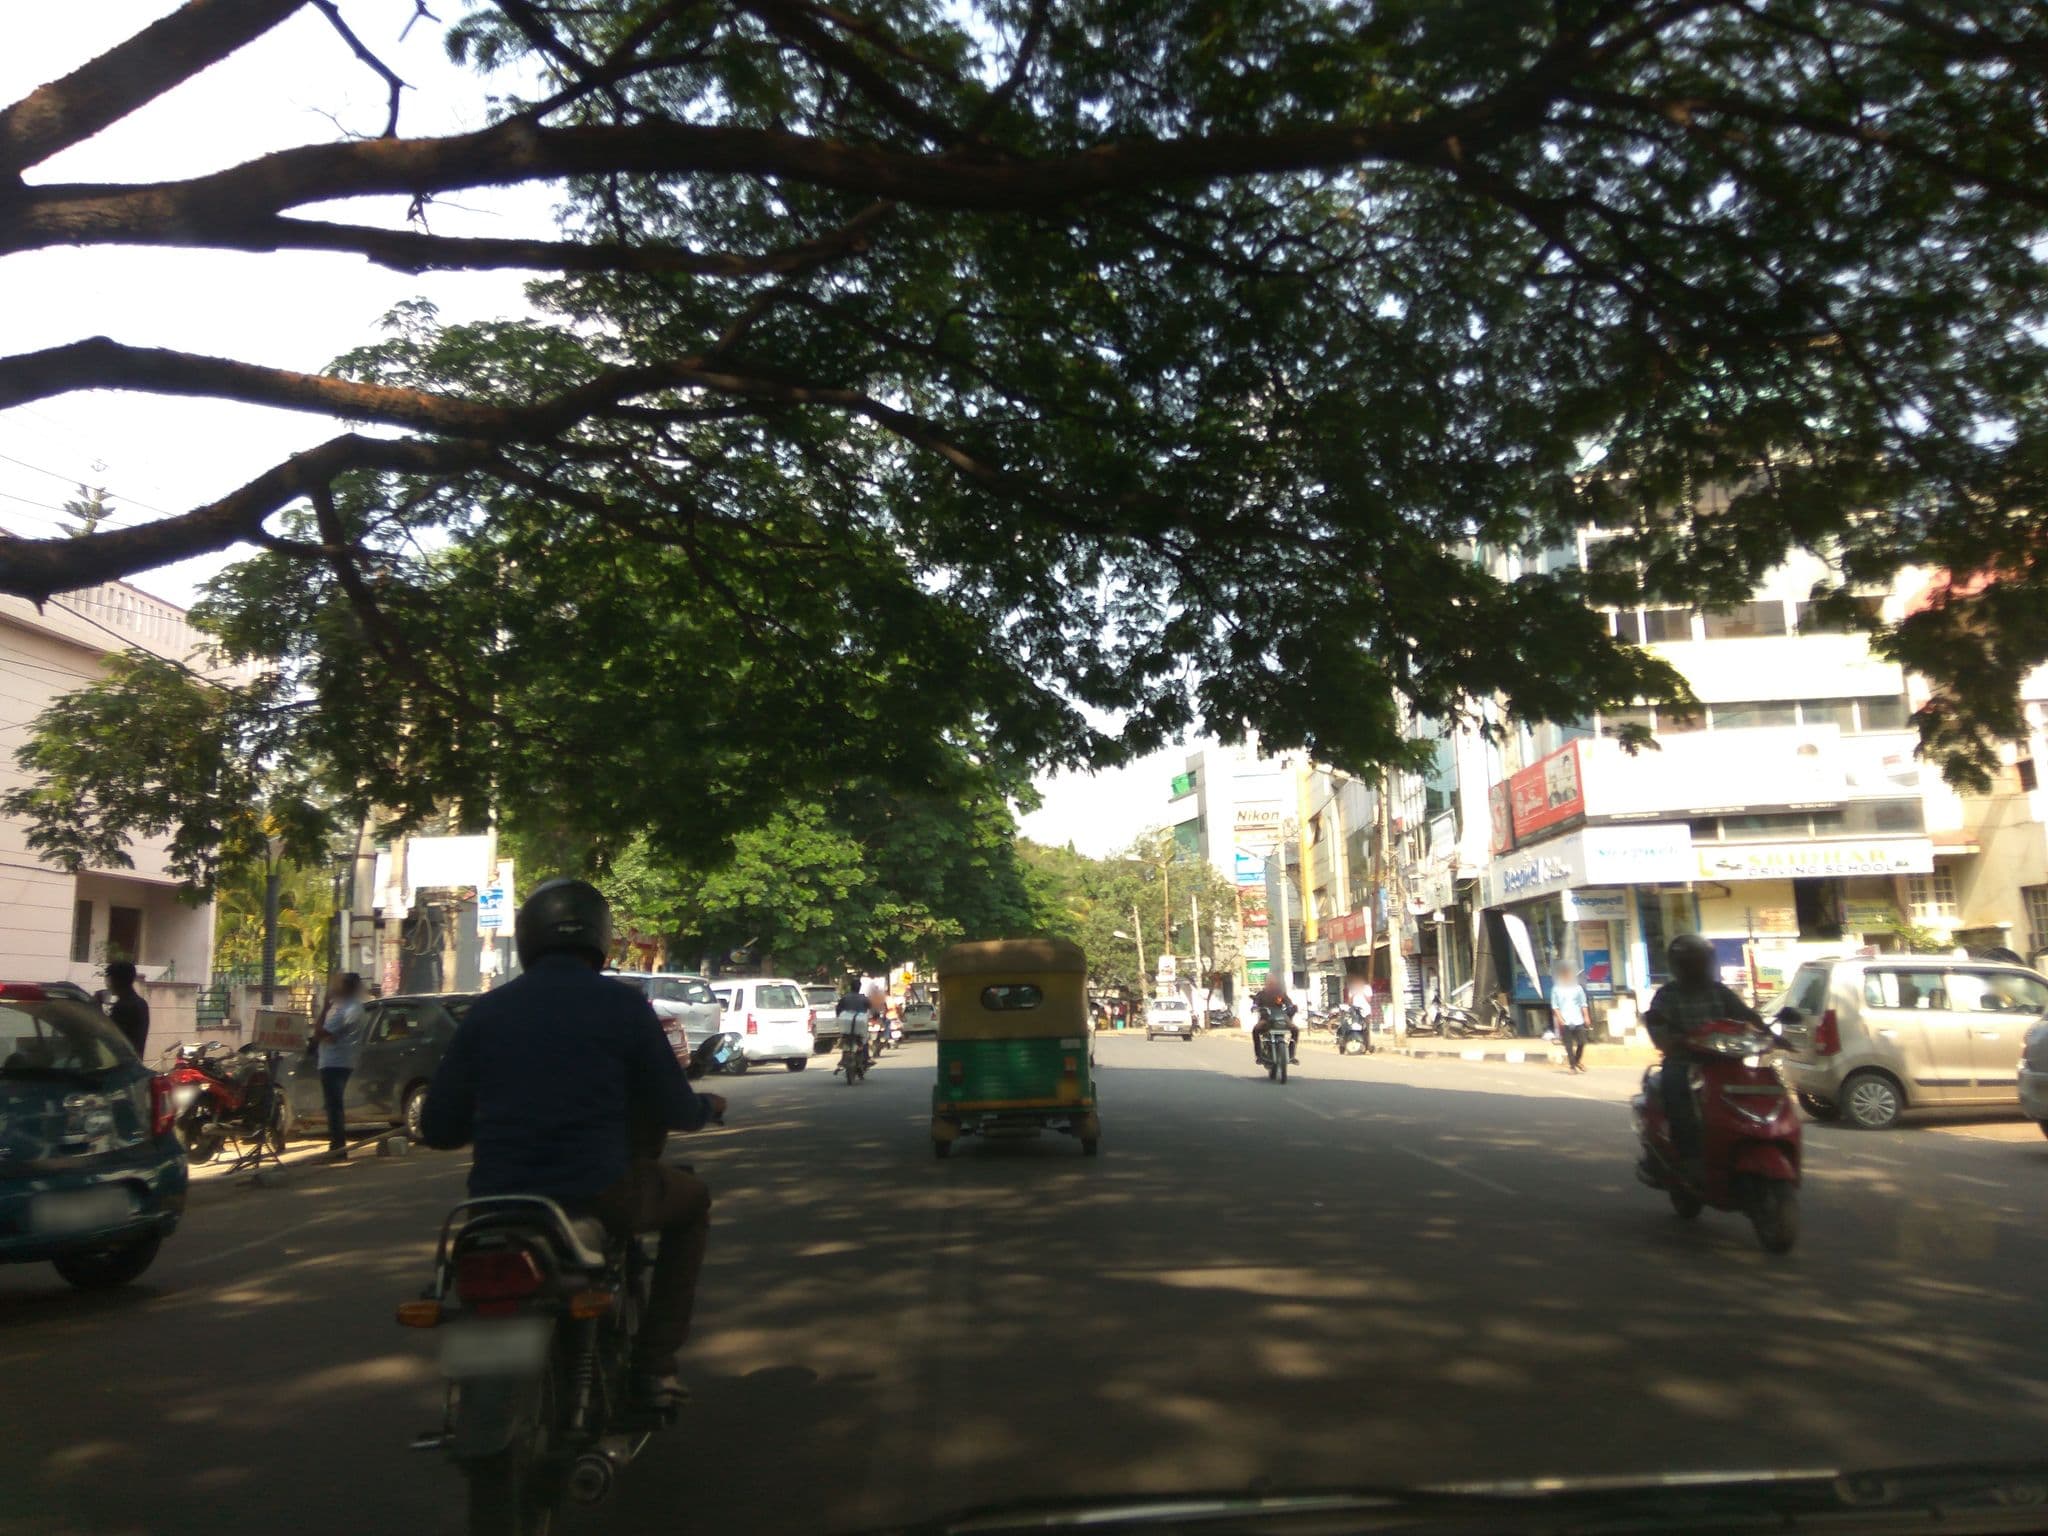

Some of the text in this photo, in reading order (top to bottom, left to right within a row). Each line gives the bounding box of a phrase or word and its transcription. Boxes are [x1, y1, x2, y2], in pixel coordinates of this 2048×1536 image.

[1237, 810, 1280, 822] Nikon
[1749, 863, 1895, 877] DRIVING SCHOOL
